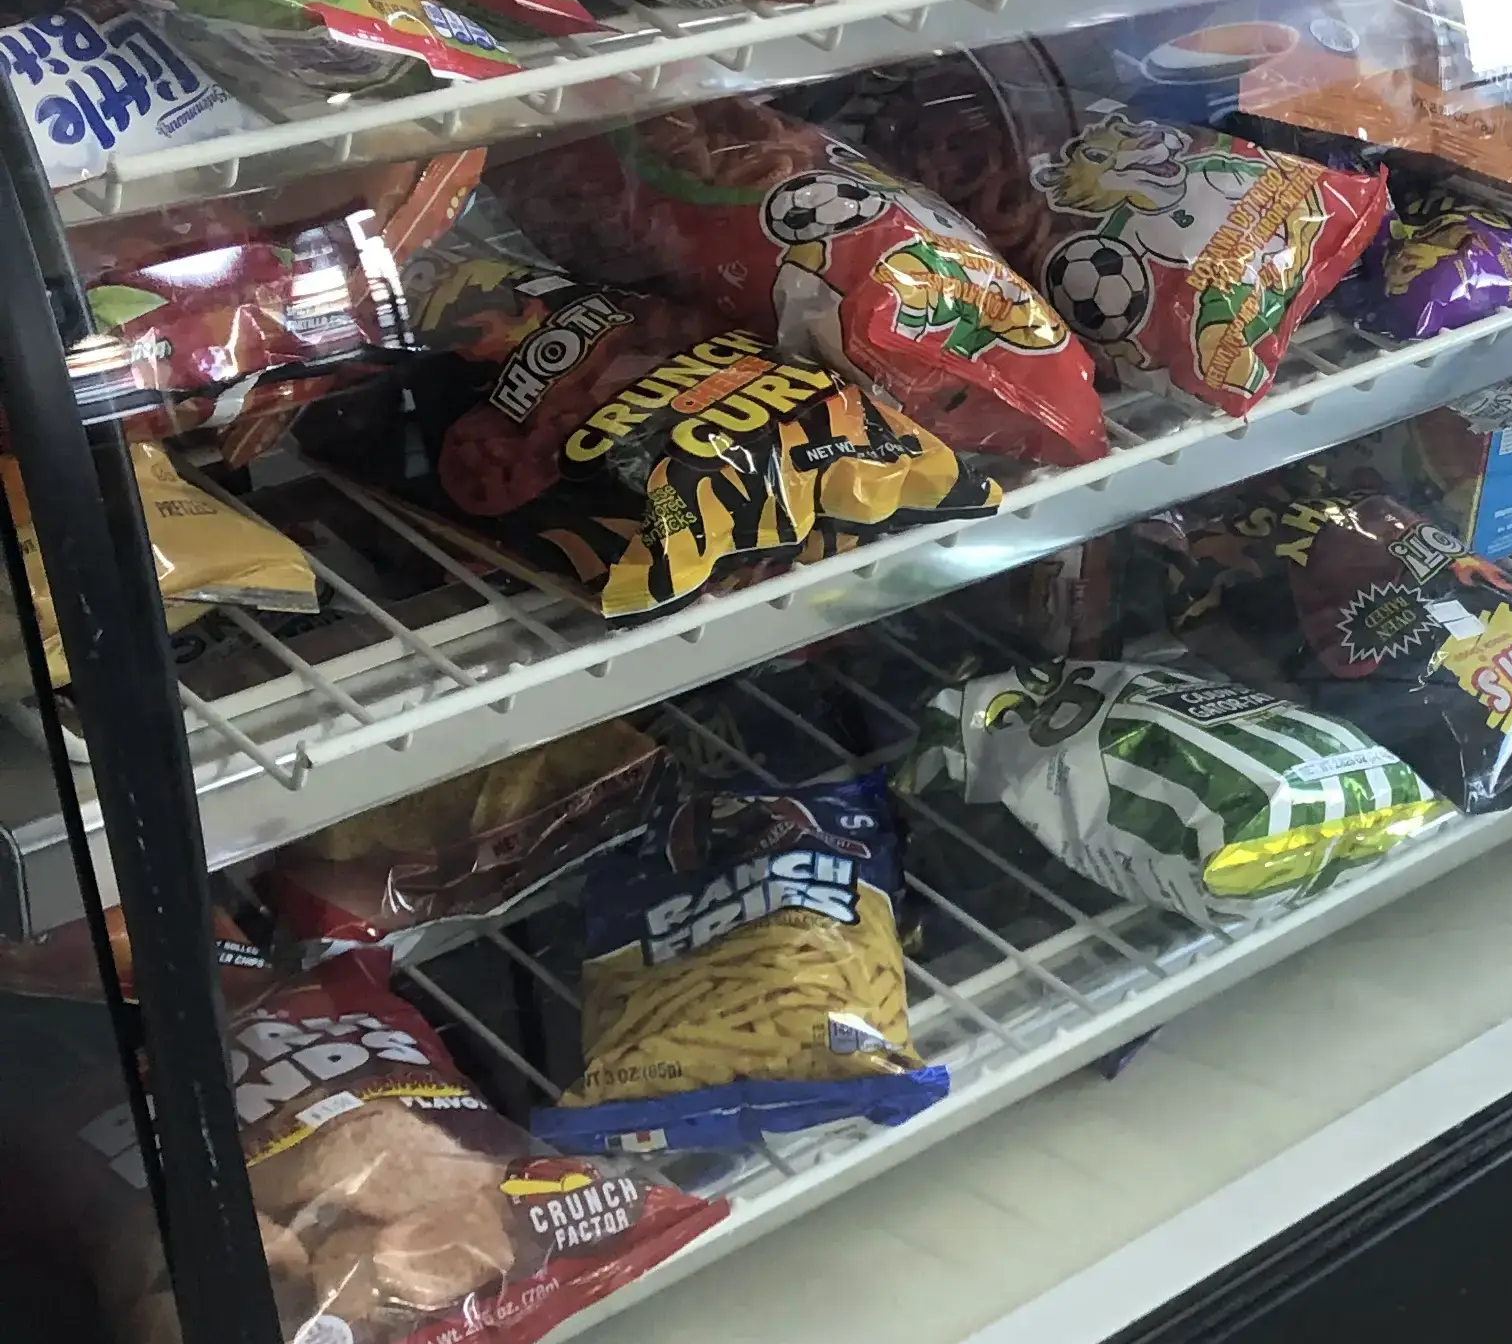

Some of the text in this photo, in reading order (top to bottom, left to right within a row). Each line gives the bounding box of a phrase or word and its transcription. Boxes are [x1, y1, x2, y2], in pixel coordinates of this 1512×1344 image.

[35, 18, 200, 150] Little
[1186, 223, 1243, 292] BOTANA
[1229, 206, 1254, 232] DE
[1247, 167, 1284, 215] TRIGO
[1255, 204, 1290, 244] SABOR
[496, 294, 633, 421] HOT!
[566, 329, 774, 462] CRUNCH
[671, 359, 834, 458] CURL
[806, 444, 835, 462] NET
[154, 499, 218, 518] PRETZELS
[642, 511, 697, 546] snacks
[1390, 523, 1469, 583] OT!
[1363, 596, 1410, 630] BAKED
[1376, 607, 1418, 641] OVEN
[646, 849, 855, 937] RANCH
[650, 879, 859, 964] FRIES
[235, 1030, 431, 1124] NDS
[529, 1176, 639, 1235] CRUNCH
[555, 1208, 629, 1252] FACTOR
